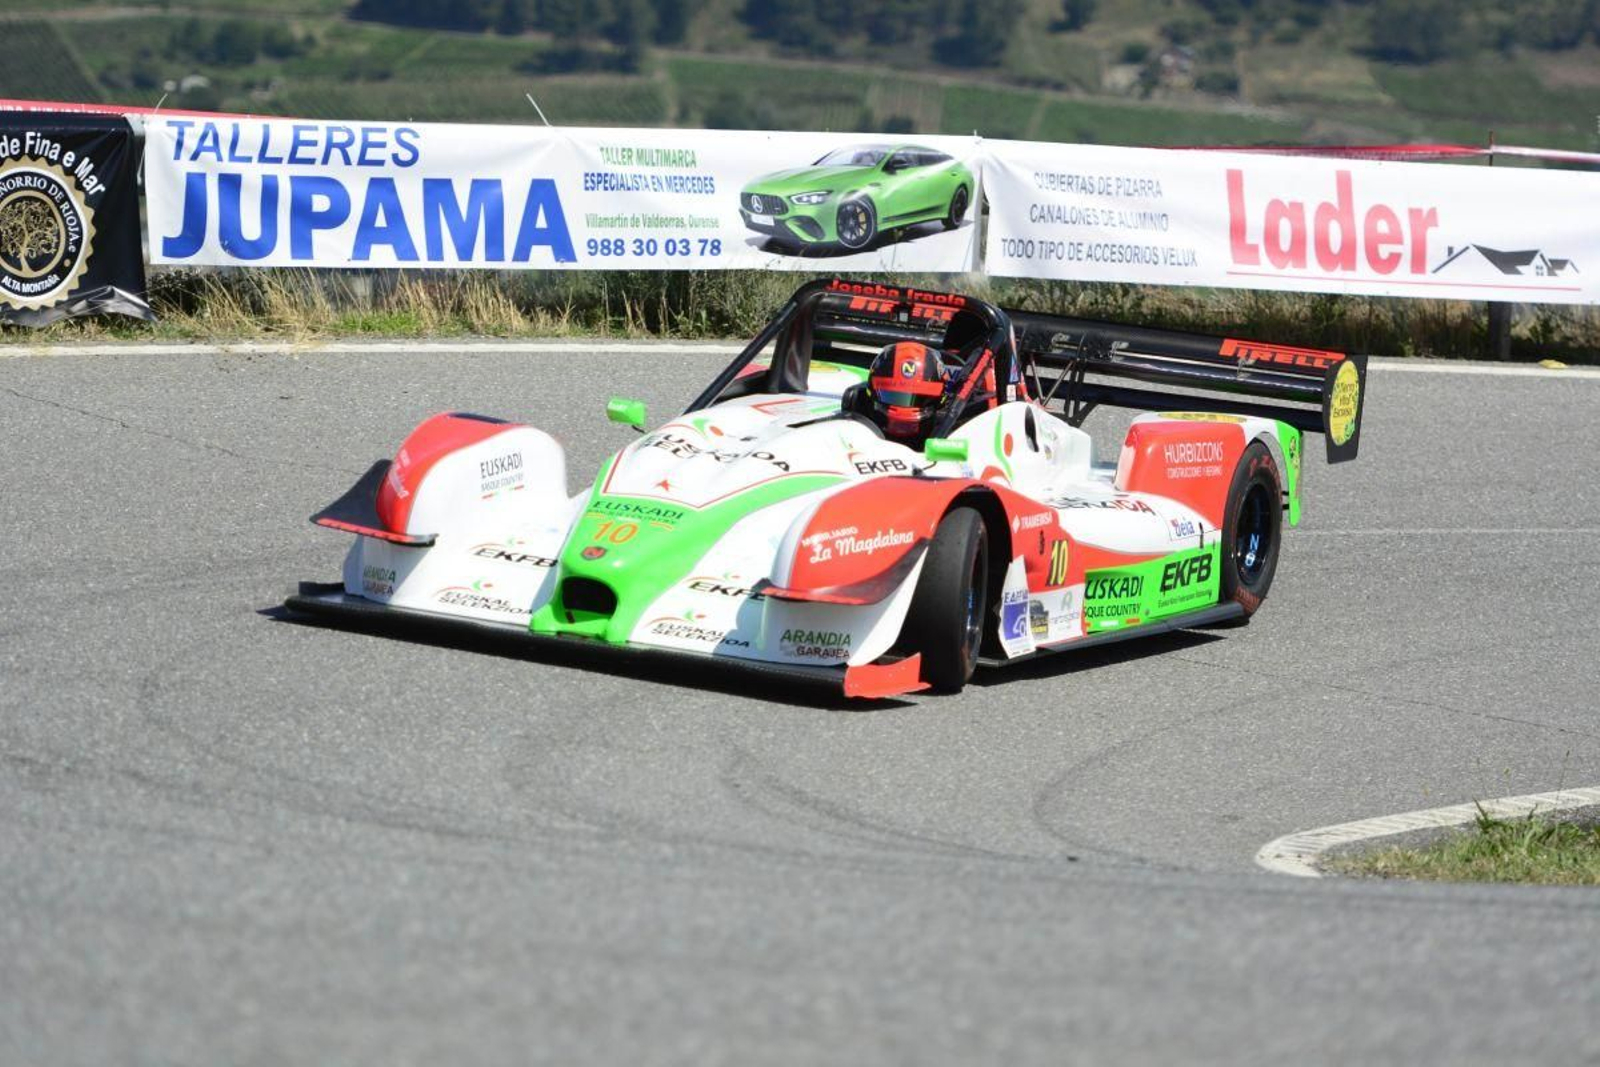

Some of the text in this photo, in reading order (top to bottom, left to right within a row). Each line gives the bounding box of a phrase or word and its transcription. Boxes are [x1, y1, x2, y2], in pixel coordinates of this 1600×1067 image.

[166, 120, 420, 168] TALLERES
[25, 131, 62, 161] Fina
[62, 151, 75, 167] e
[74, 157, 106, 195] Mar
[600, 146, 697, 168] TALLER MULTIMARCA
[48, 184, 65, 203] DE
[584, 172, 715, 195] ESPECIALISTA EN MERCEDES
[1034, 172, 1163, 198] CUBIERTAS DE PIZARRA
[162, 172, 578, 263] JUPAMA
[630, 213, 640, 228] de
[1030, 203, 1169, 232] CANALONES DE ALUMINIO
[1226, 169, 1439, 275] Lader
[586, 238, 722, 257] 988 30 03 78
[1001, 239, 1198, 267] TODO TIPO DE ACCESORIOS VELUX
[2, 274, 61, 294] ALTA MONTAÑA
[1163, 441, 1224, 464] HURBIZCONS
[480, 452, 523, 479] EUSKADI
[854, 459, 908, 475] EKFB
[593, 501, 684, 520] EUSKADI
[594, 521, 638, 544] 10
[474, 547, 559, 568] EKFB
[809, 528, 915, 564] La Magdalena
[1046, 539, 1069, 587] 10
[1159, 552, 1213, 593] EKFB
[445, 591, 511, 607] EUSKAL
[1106, 602, 1141, 617] COUNTRY
[656, 622, 725, 637] EUSKAL
[780, 629, 851, 647] ARANDIA
[796, 646, 850, 659] GARAJEA
